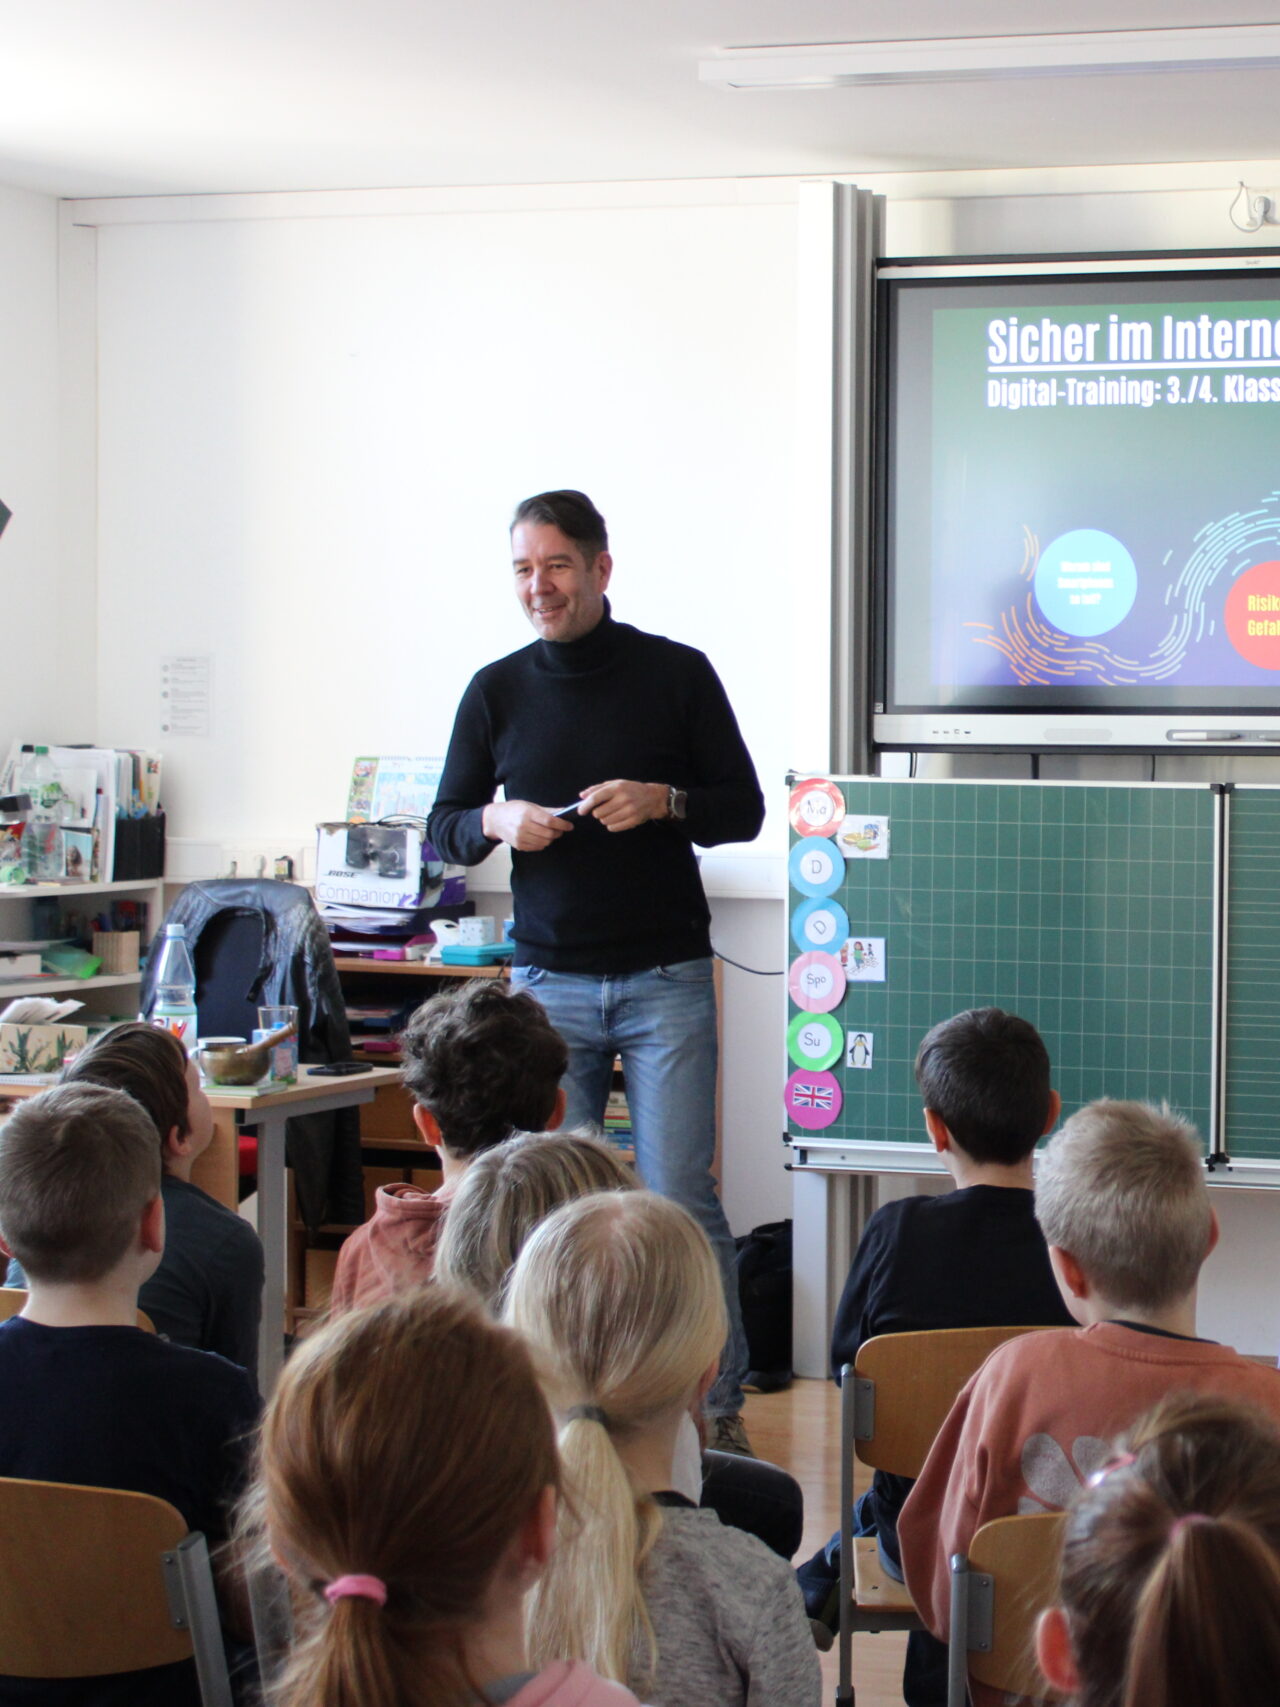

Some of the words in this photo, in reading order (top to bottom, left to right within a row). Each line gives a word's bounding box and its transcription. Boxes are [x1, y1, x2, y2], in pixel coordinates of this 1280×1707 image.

[988, 316, 1100, 364] Sicher
[1109, 314, 1152, 361] im
[987, 376, 1162, 410] Digital-Training:
[1167, 375, 1218, 404] 3./4.
[811, 859, 823, 874] D
[318, 882, 401, 904] Companion
[813, 920, 827, 935] D
[806, 973, 826, 989] Spo
[804, 1032, 821, 1047] Su
